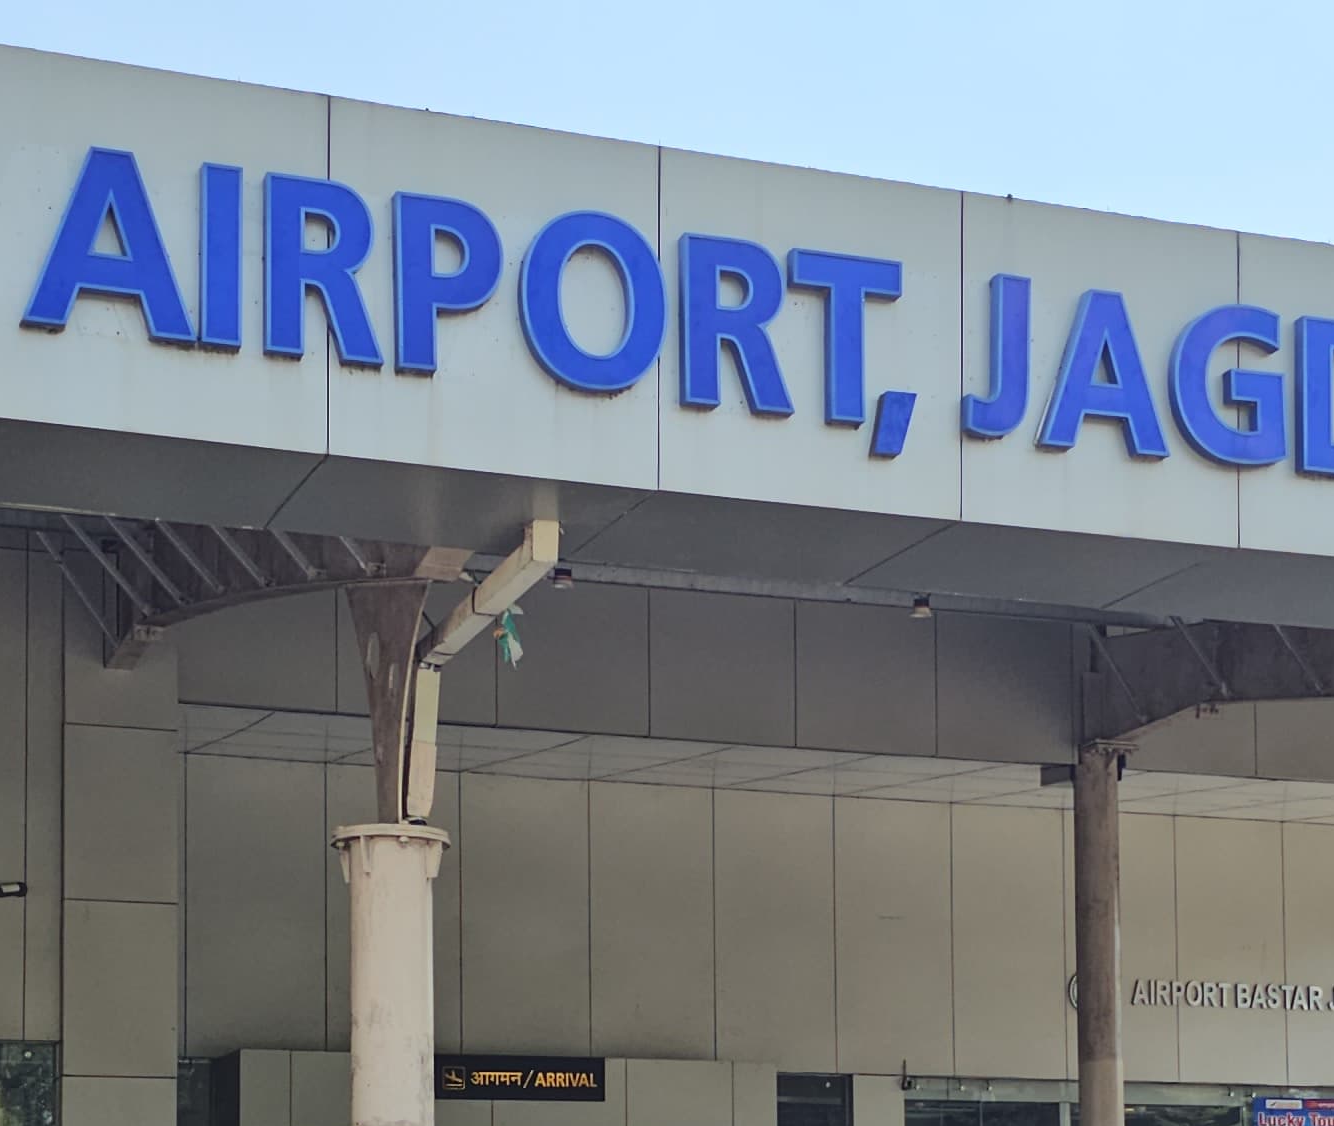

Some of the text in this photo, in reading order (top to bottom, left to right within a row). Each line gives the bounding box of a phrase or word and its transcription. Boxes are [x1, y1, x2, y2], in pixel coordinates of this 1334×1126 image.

[20, 145, 916, 458] AIRPORT,
[1131, 979, 1231, 1009] AIRPORT
[1235, 983, 1324, 1012] BASTAR
[470, 1071, 523, 1086] आगमन
[534, 1072, 598, 1088] ARRIVAL
